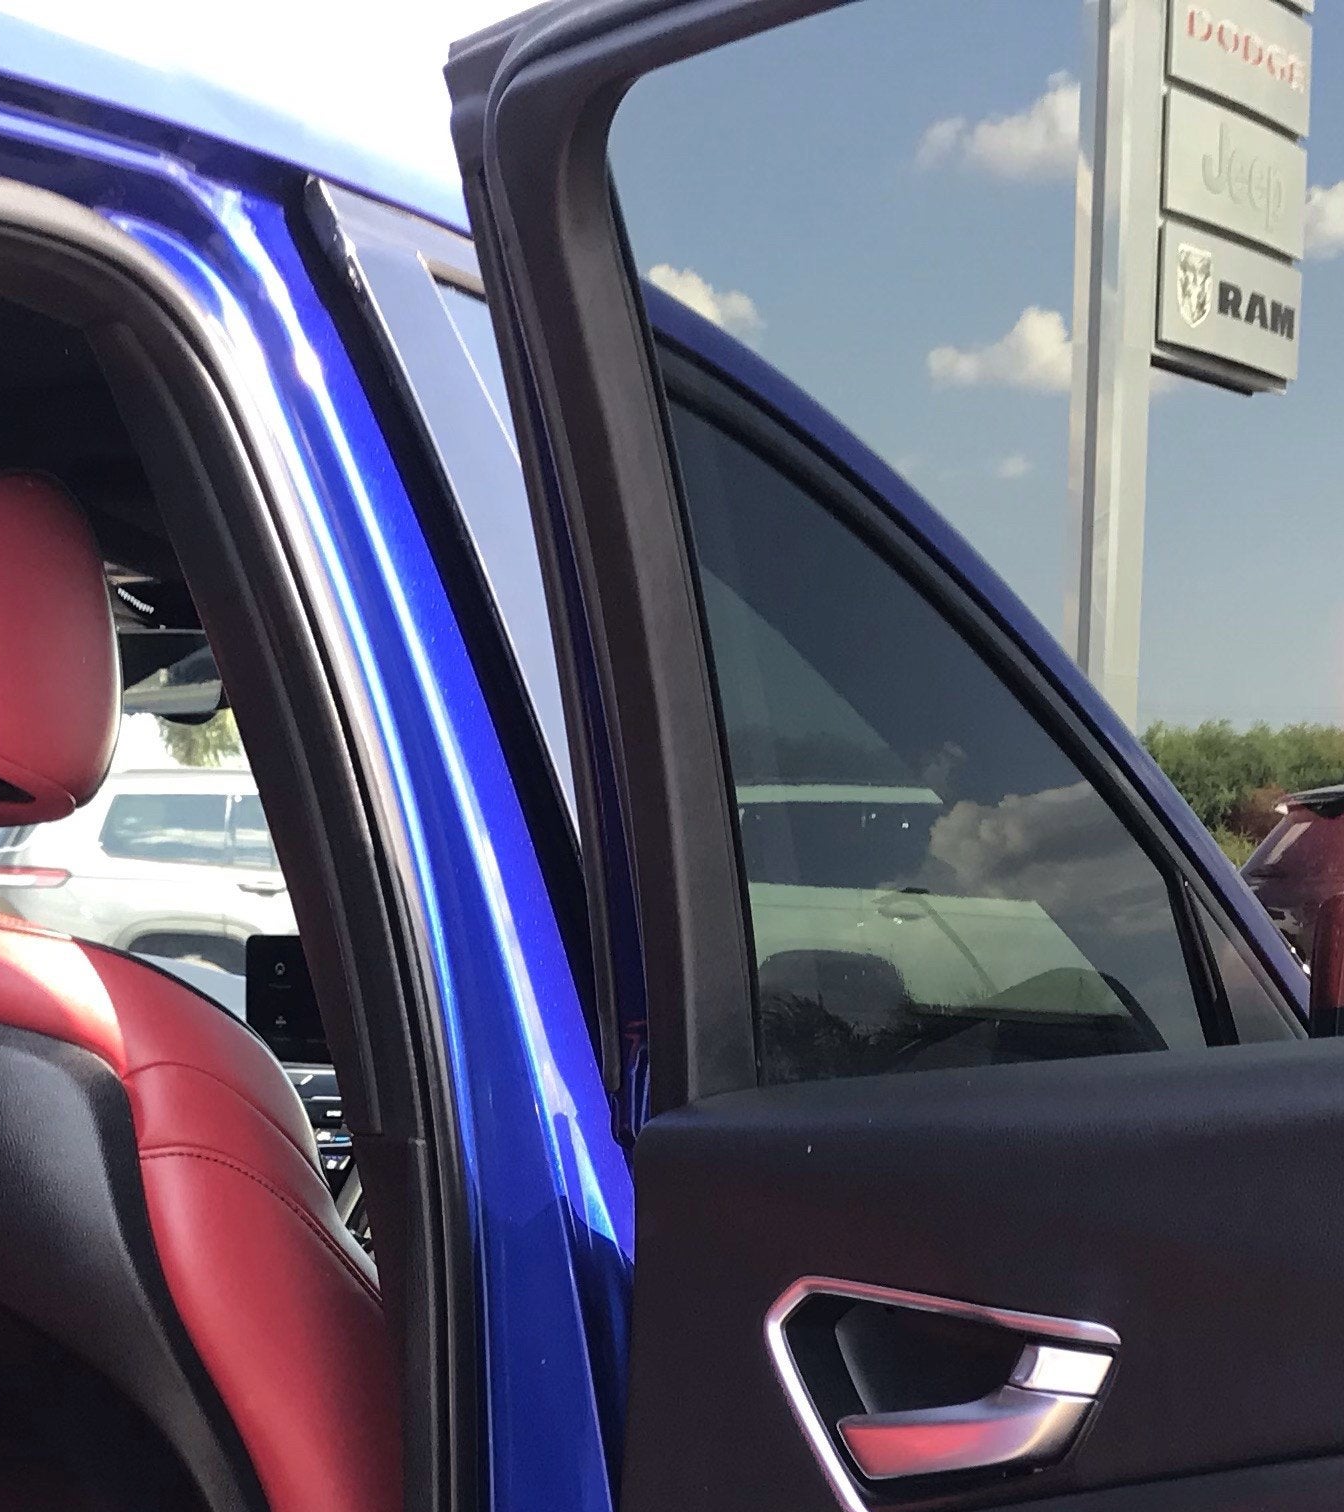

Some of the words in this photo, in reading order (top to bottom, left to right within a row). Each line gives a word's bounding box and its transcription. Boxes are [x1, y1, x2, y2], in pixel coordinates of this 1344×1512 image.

[1187, 6, 1306, 93] DODGE
[1201, 120, 1283, 233] Jeep
[1218, 280, 1295, 341] RAM
